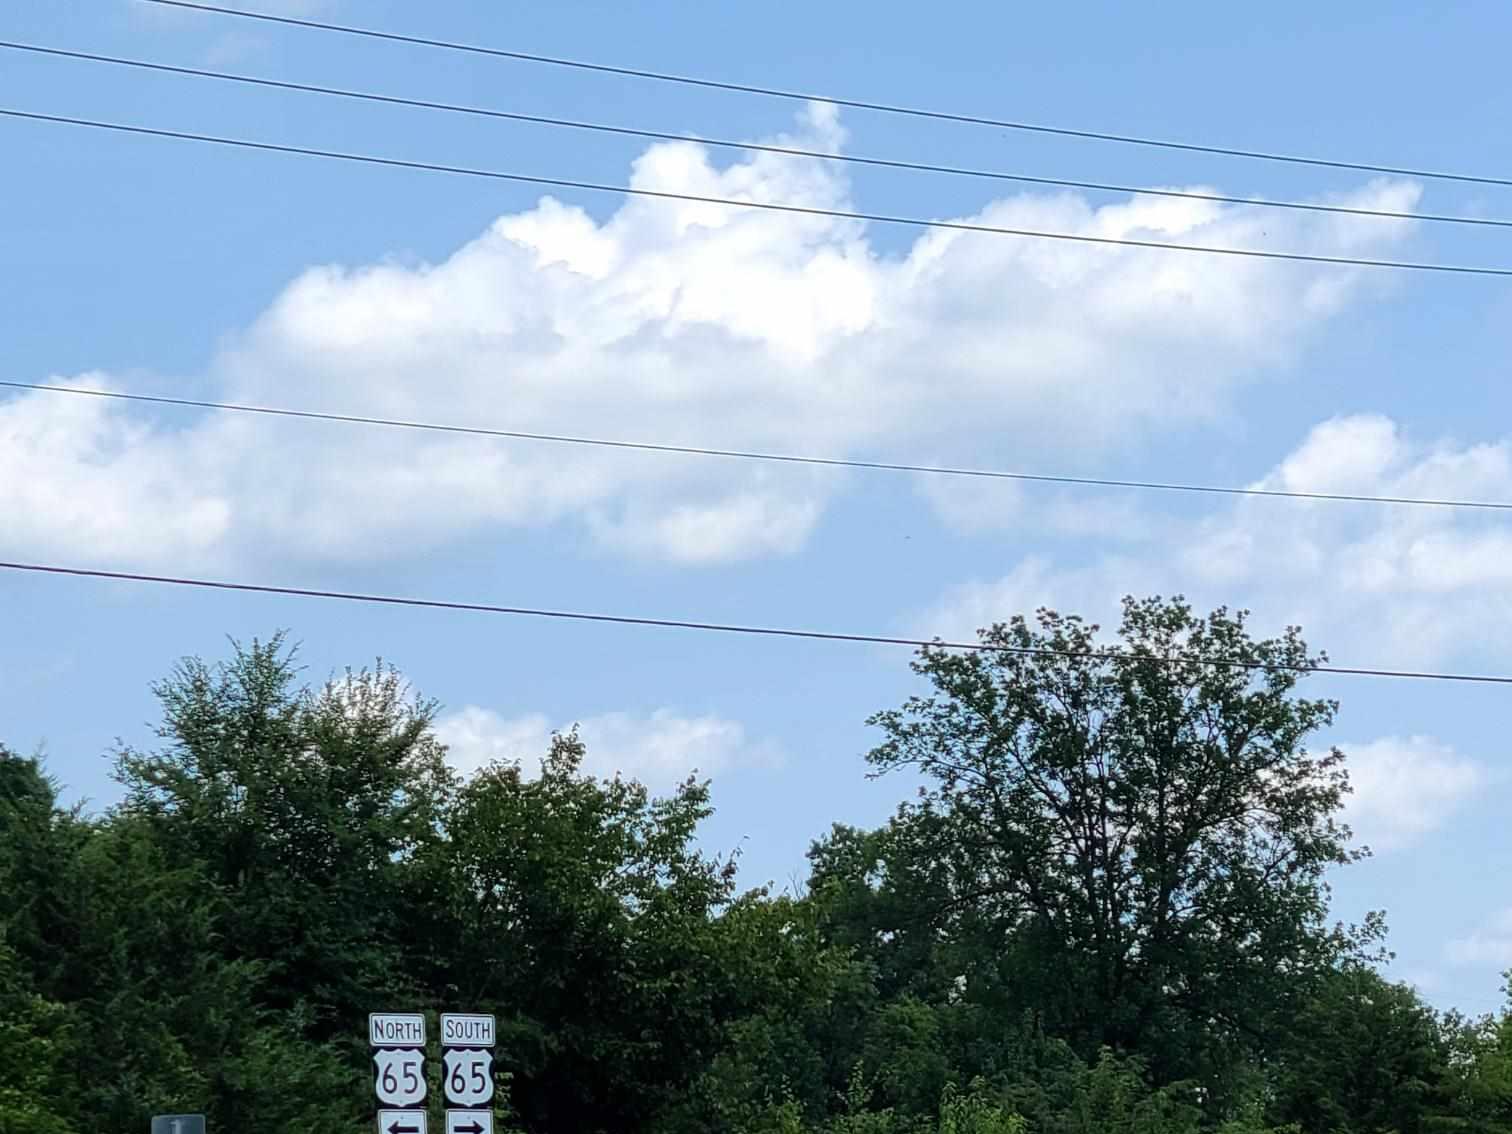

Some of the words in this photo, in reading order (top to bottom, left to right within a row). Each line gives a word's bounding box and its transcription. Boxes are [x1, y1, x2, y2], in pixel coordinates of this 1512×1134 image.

[373, 1019, 423, 1040] NORTH
[445, 1019, 491, 1040] SOUTH
[382, 1061, 418, 1095] 65
[450, 1061, 486, 1094] 65
